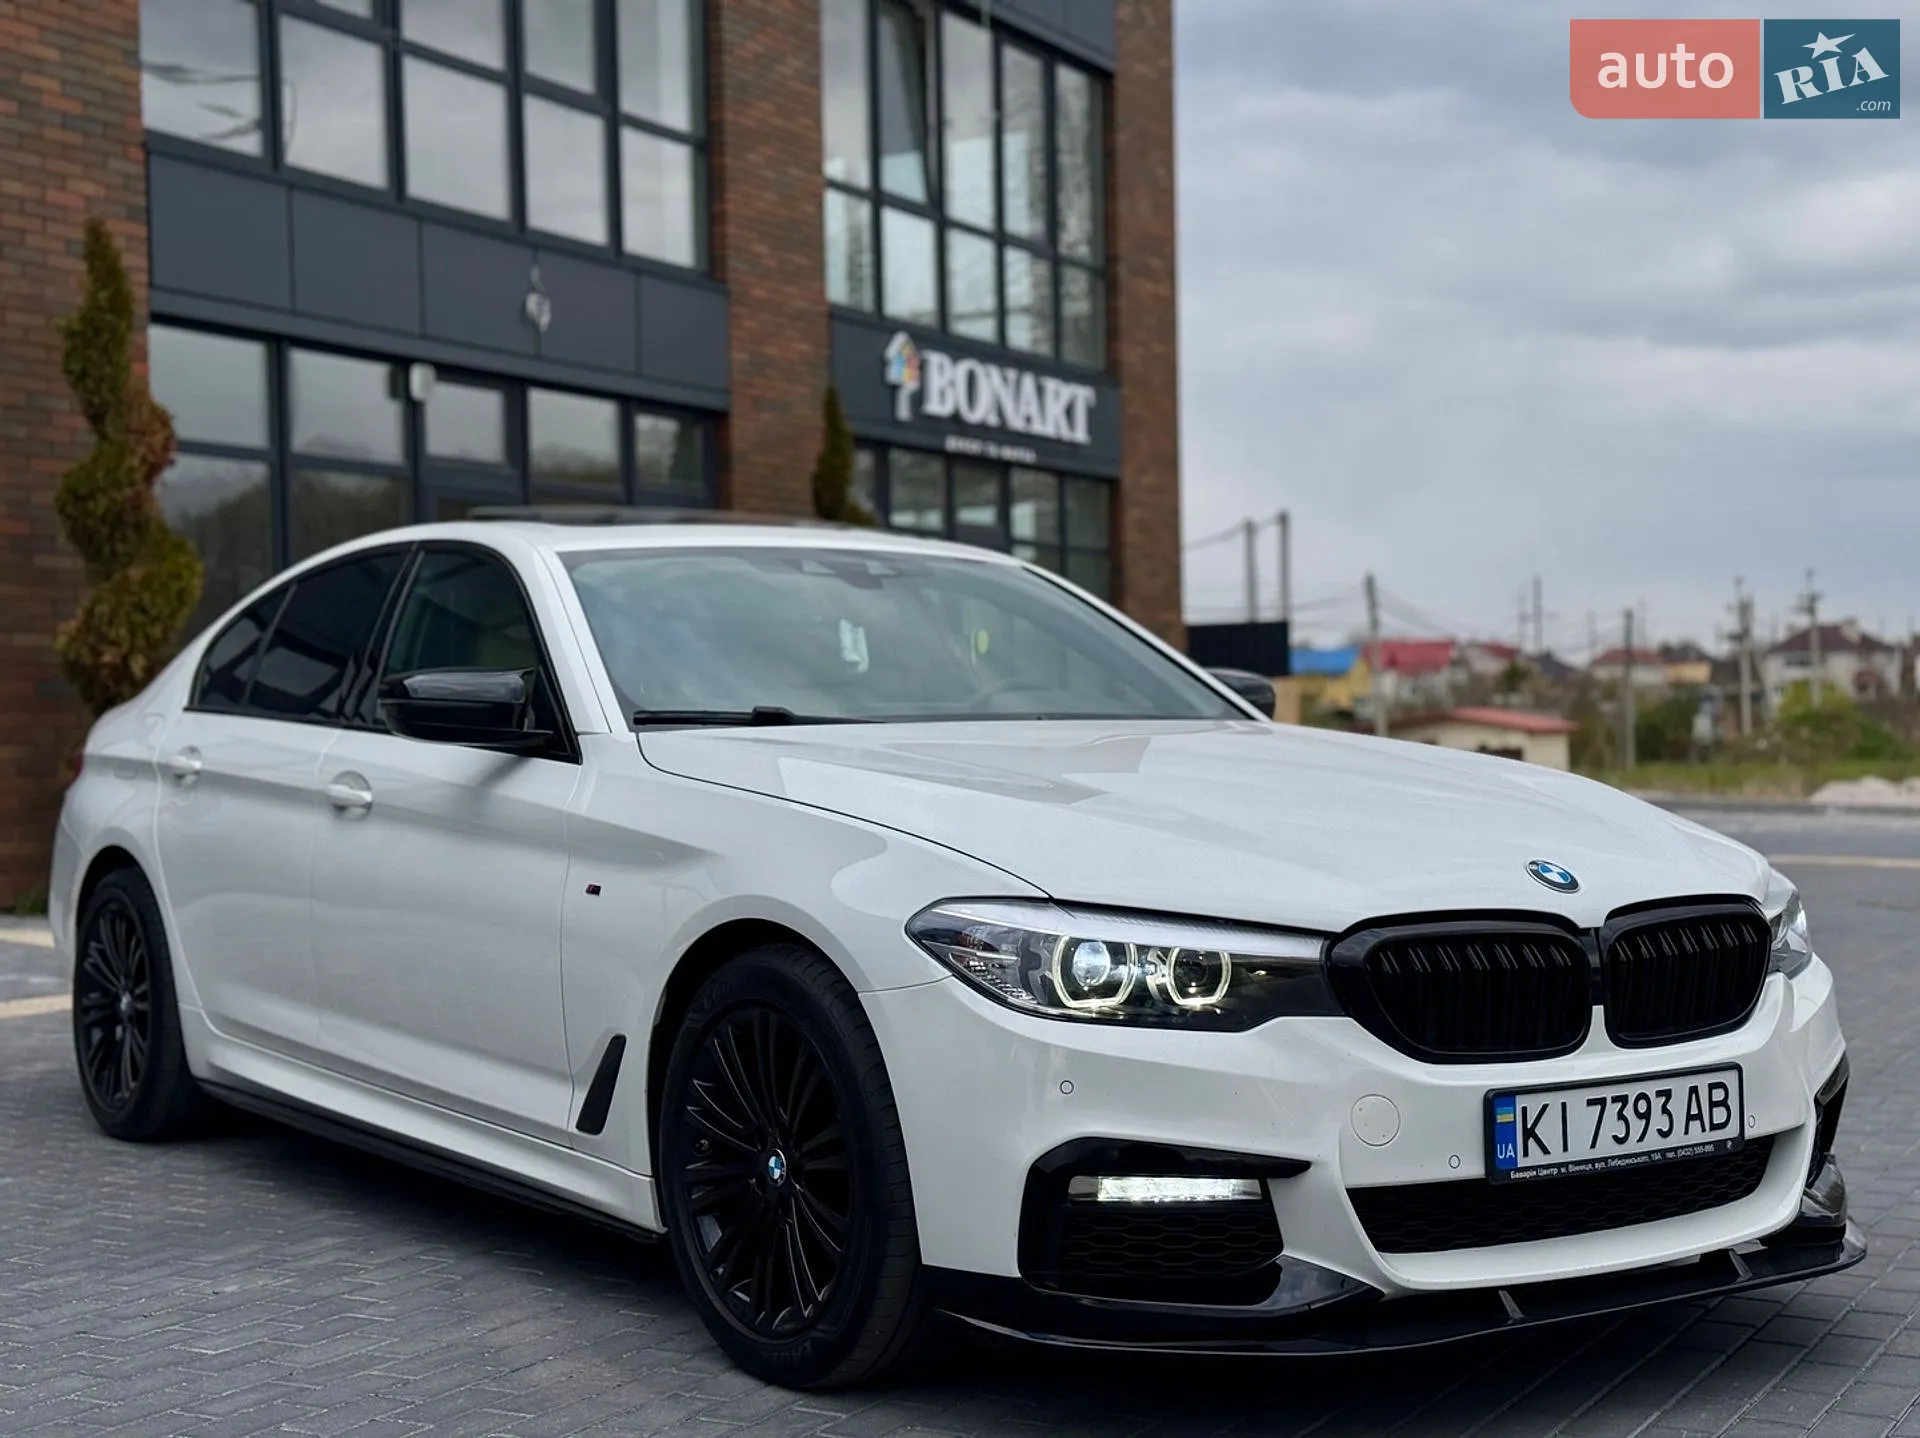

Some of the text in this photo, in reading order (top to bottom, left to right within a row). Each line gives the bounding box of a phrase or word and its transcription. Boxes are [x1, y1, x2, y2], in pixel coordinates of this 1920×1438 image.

[921, 349, 1097, 445] BONART
[1497, 1143, 1515, 1159] UA
[1521, 1081, 1732, 1158] KI 7393 AB
